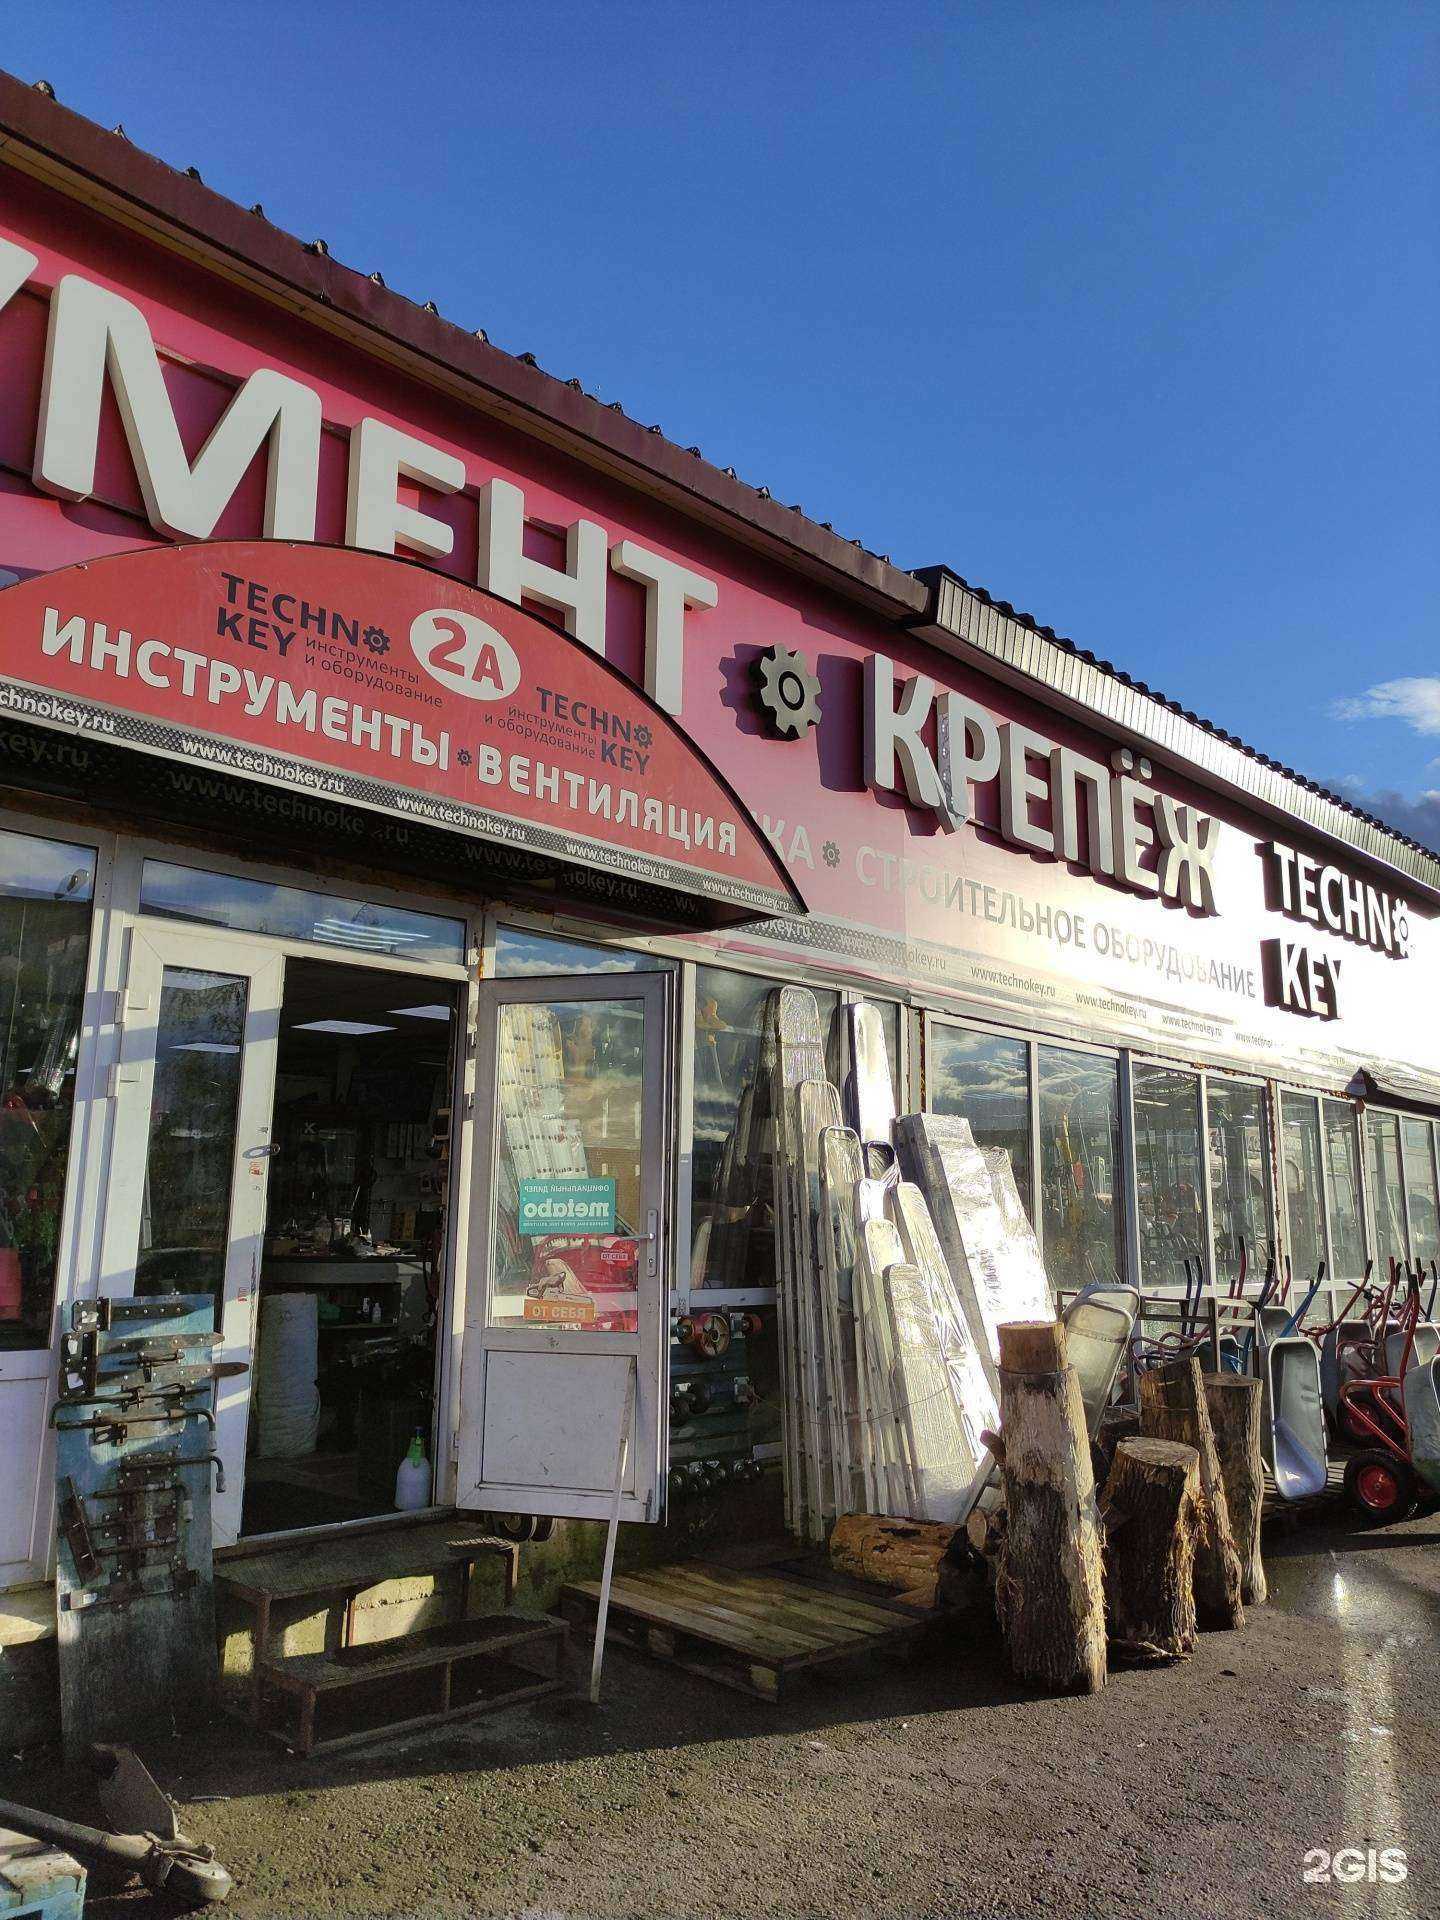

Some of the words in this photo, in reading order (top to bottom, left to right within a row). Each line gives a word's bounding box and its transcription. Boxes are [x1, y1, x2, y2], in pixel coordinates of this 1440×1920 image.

[0, 237, 718, 716] МЕНТ
[216, 606, 296, 657] KEY
[305, 654, 316, 667] и
[321, 657, 444, 708] оборудование
[306, 636, 420, 686] инструменты
[41, 606, 450, 771] ИНСТРУМЕНТЫ
[477, 743, 737, 857] ВЕНТИЛЯЦИЯ
[484, 714, 494, 726] и
[497, 715, 596, 759] оборудование
[508, 705, 598, 745] инструменты
[600, 743, 650, 776] KEY
[864, 653, 1220, 917] КРЕПЁЖ
[169, 769, 409, 845] www.technoke.ru
[182, 737, 345, 796] www.technokey.ru
[396, 796, 526, 842] www.technokey.ru
[566, 841, 671, 880] www.technokey.ru
[703, 878, 791, 912] www.technokey.ru
[856, 846, 1086, 949] СТРОИТЕЛЬНОЕ
[1092, 922, 1256, 999] ОБОРУДОВАНИЕ
[971, 965, 1056, 998] www.technokey.ru
[1075, 991, 1147, 1020] www.technokey.ru
[1270, 938, 1344, 1021] KEY
[531, 1305, 549, 1318] ОТ
[551, 1306, 587, 1320] СЕБЯ
